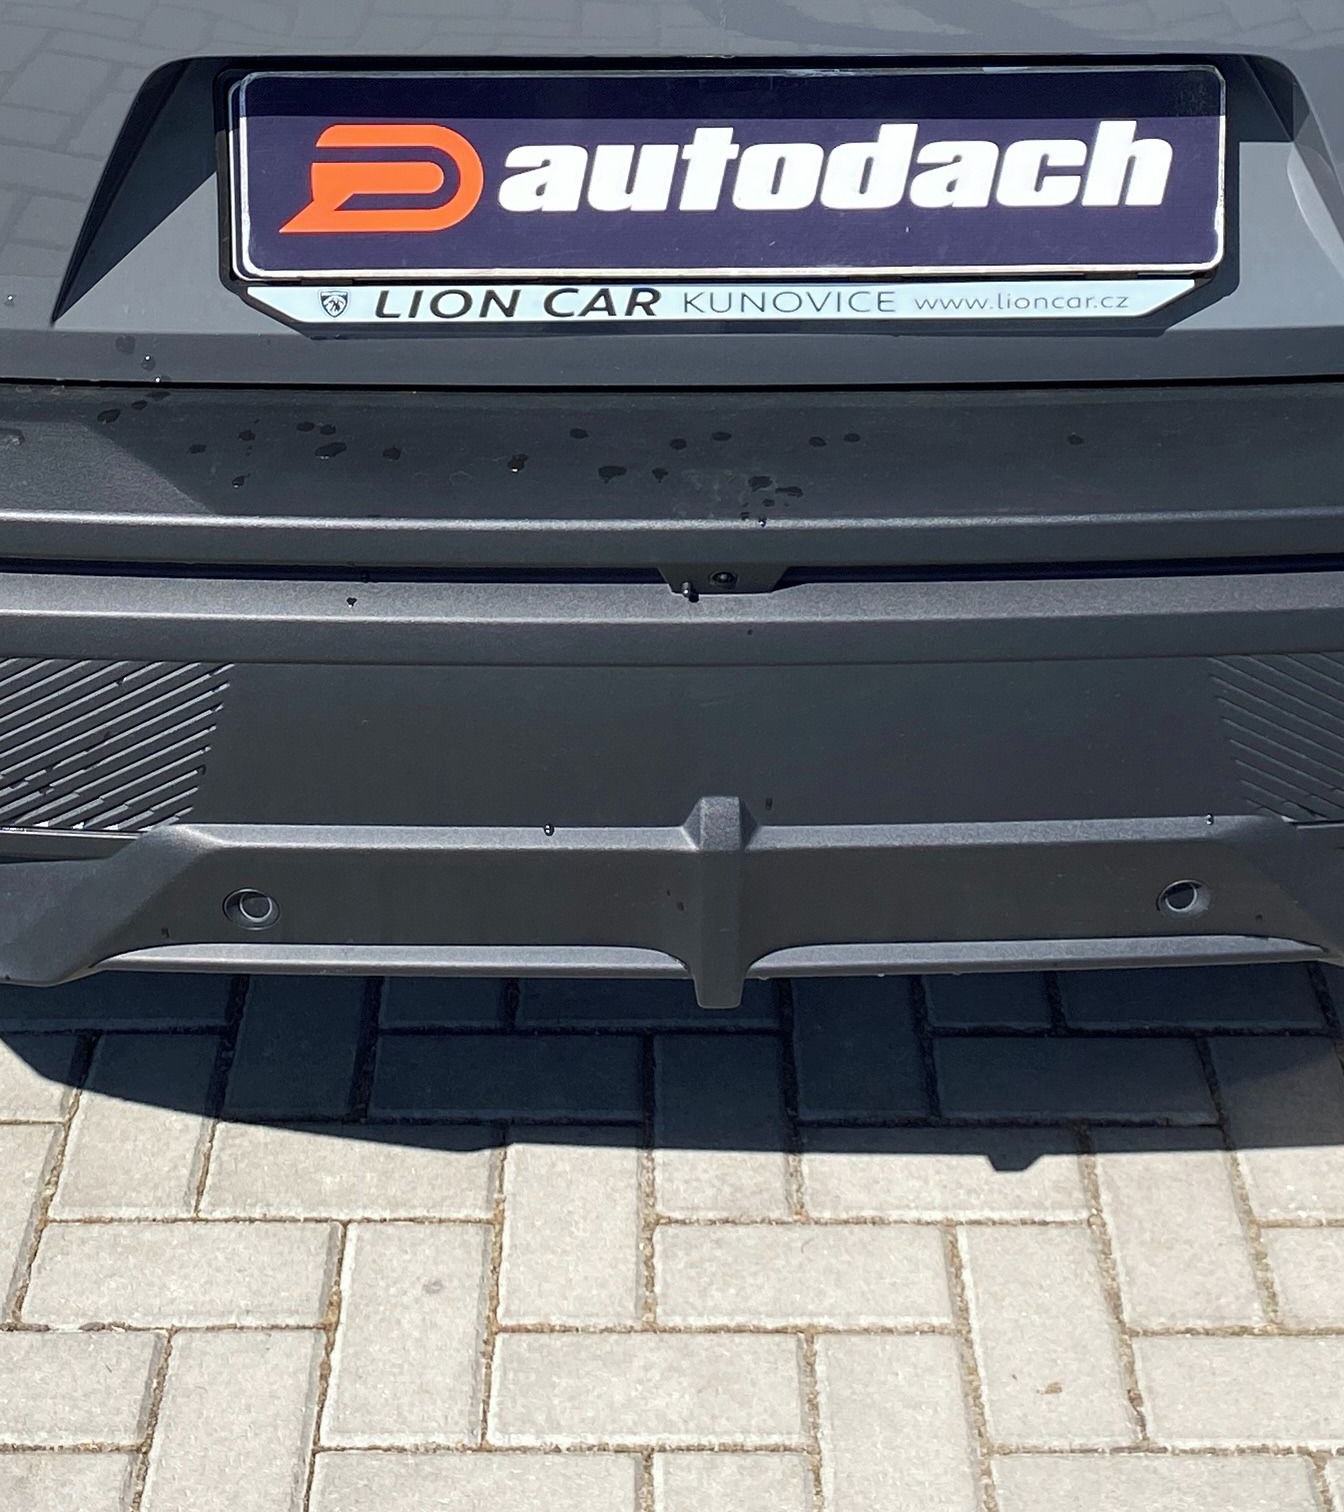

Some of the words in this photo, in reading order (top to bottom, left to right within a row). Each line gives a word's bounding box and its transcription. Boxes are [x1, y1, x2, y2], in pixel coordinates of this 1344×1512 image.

[498, 120, 1174, 213] autodach
[374, 289, 522, 320] LION
[542, 286, 662, 318] CAR
[683, 289, 897, 314] KUNOVICE
[914, 291, 1130, 311] www.lioncar.cz
